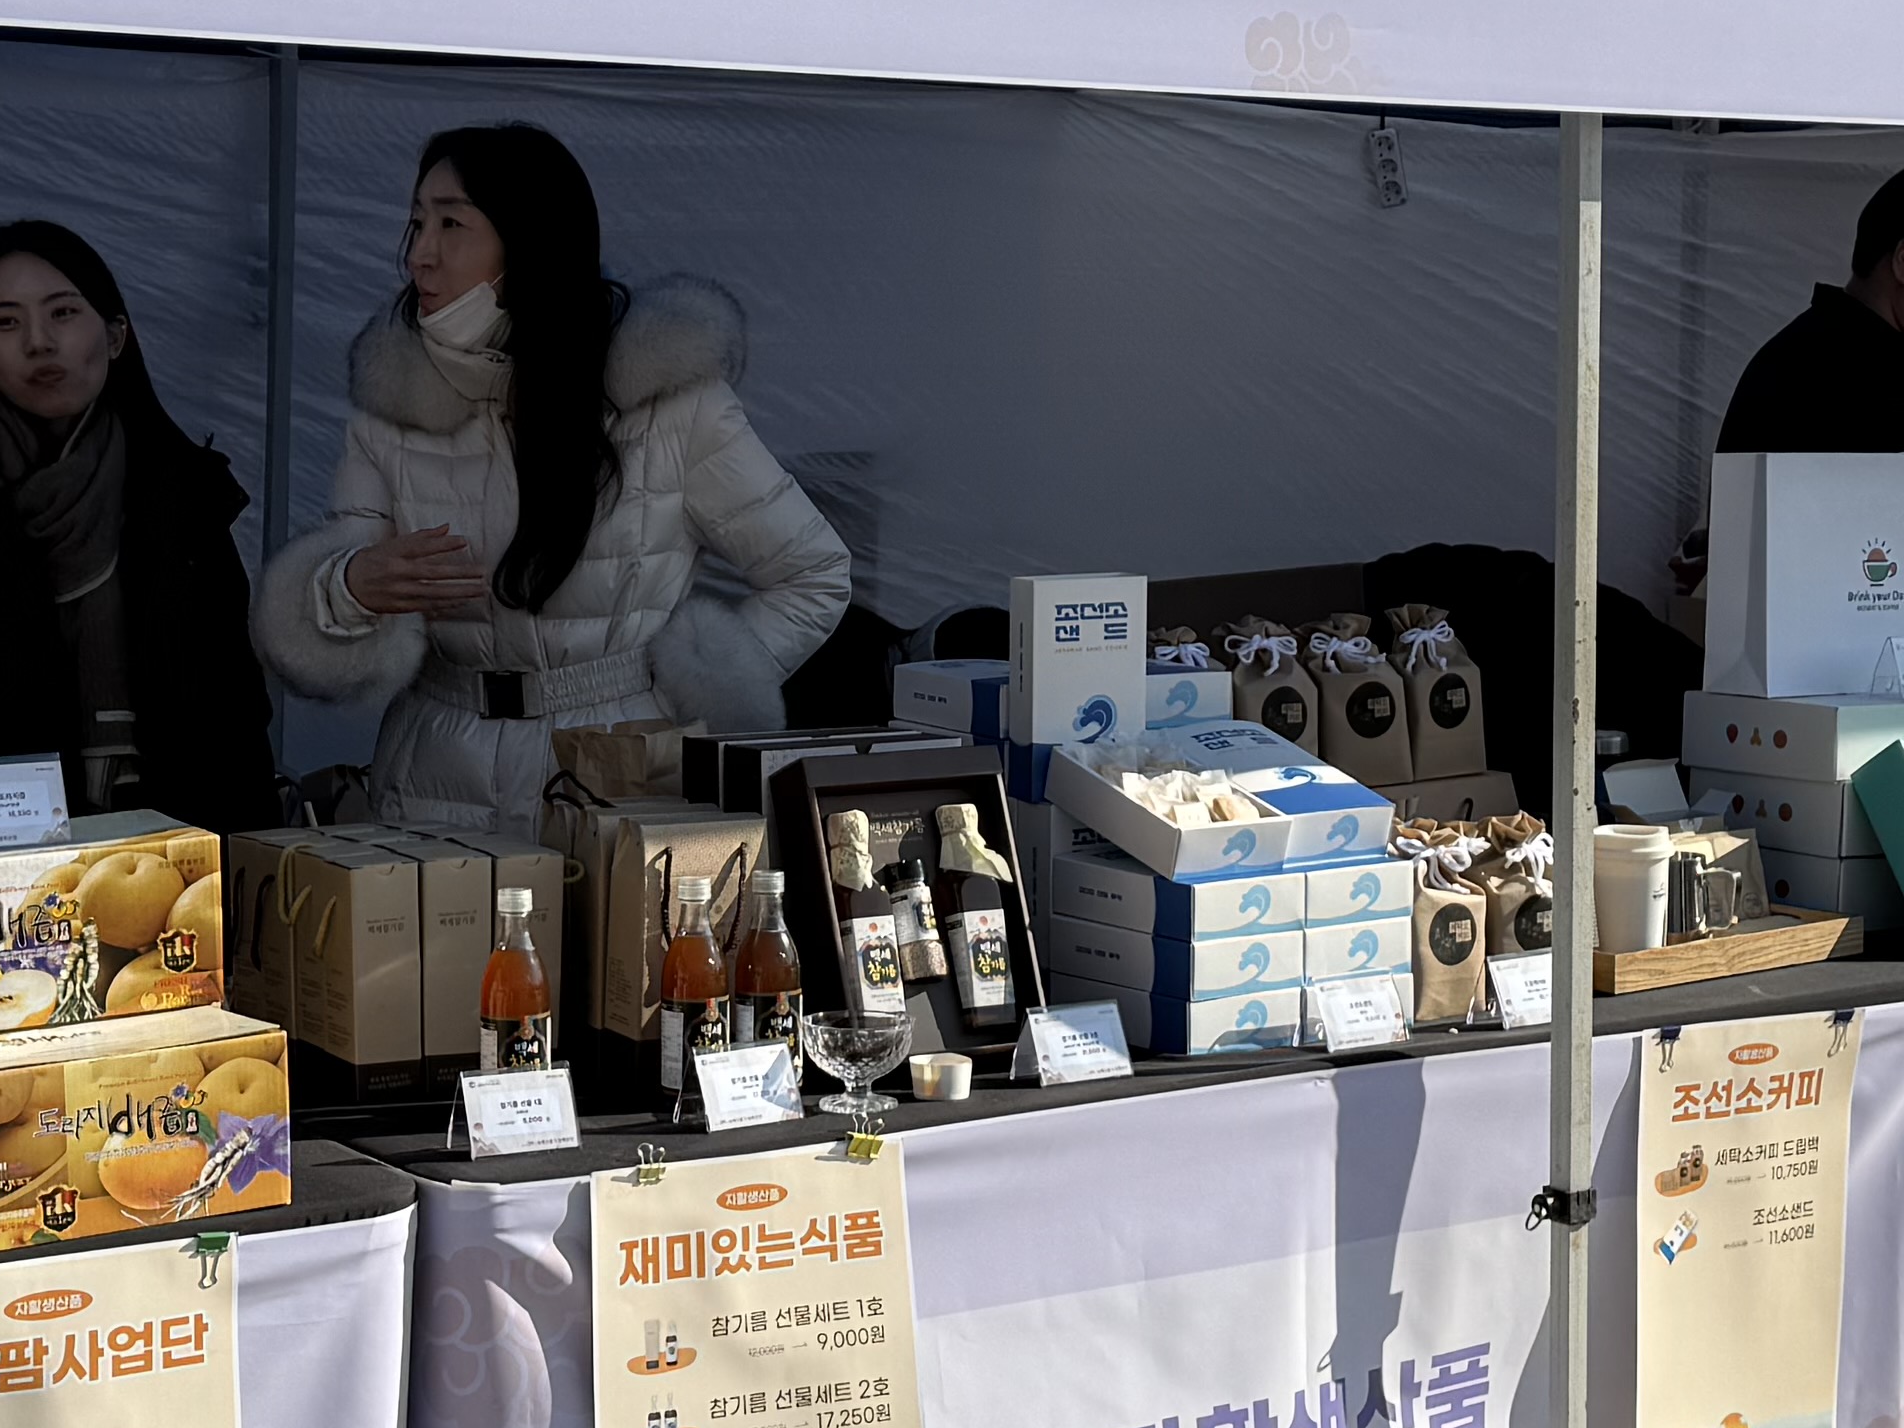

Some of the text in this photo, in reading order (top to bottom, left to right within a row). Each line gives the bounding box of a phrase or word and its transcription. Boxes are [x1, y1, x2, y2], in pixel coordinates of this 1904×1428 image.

[1671, 1067, 1825, 1125] 조선소커피
[32, 1090, 184, 1142] 도라지배즙
[1714, 1135, 1820, 1167] 세탁소커피 드립백
[1770, 1159, 1819, 1181] 10,750원
[1752, 1199, 1815, 1227] 조선소샌드
[618, 1208, 885, 1288] 재미있는식품
[1768, 1222, 1815, 1245] 11,600원
[13, 1292, 85, 1318] 자활생산품
[711, 1295, 885, 1338] 참기름 선물세트 1호
[816, 1324, 886, 1352] 9,000원
[709, 1376, 891, 1420] 참기름 선물세트 2호
